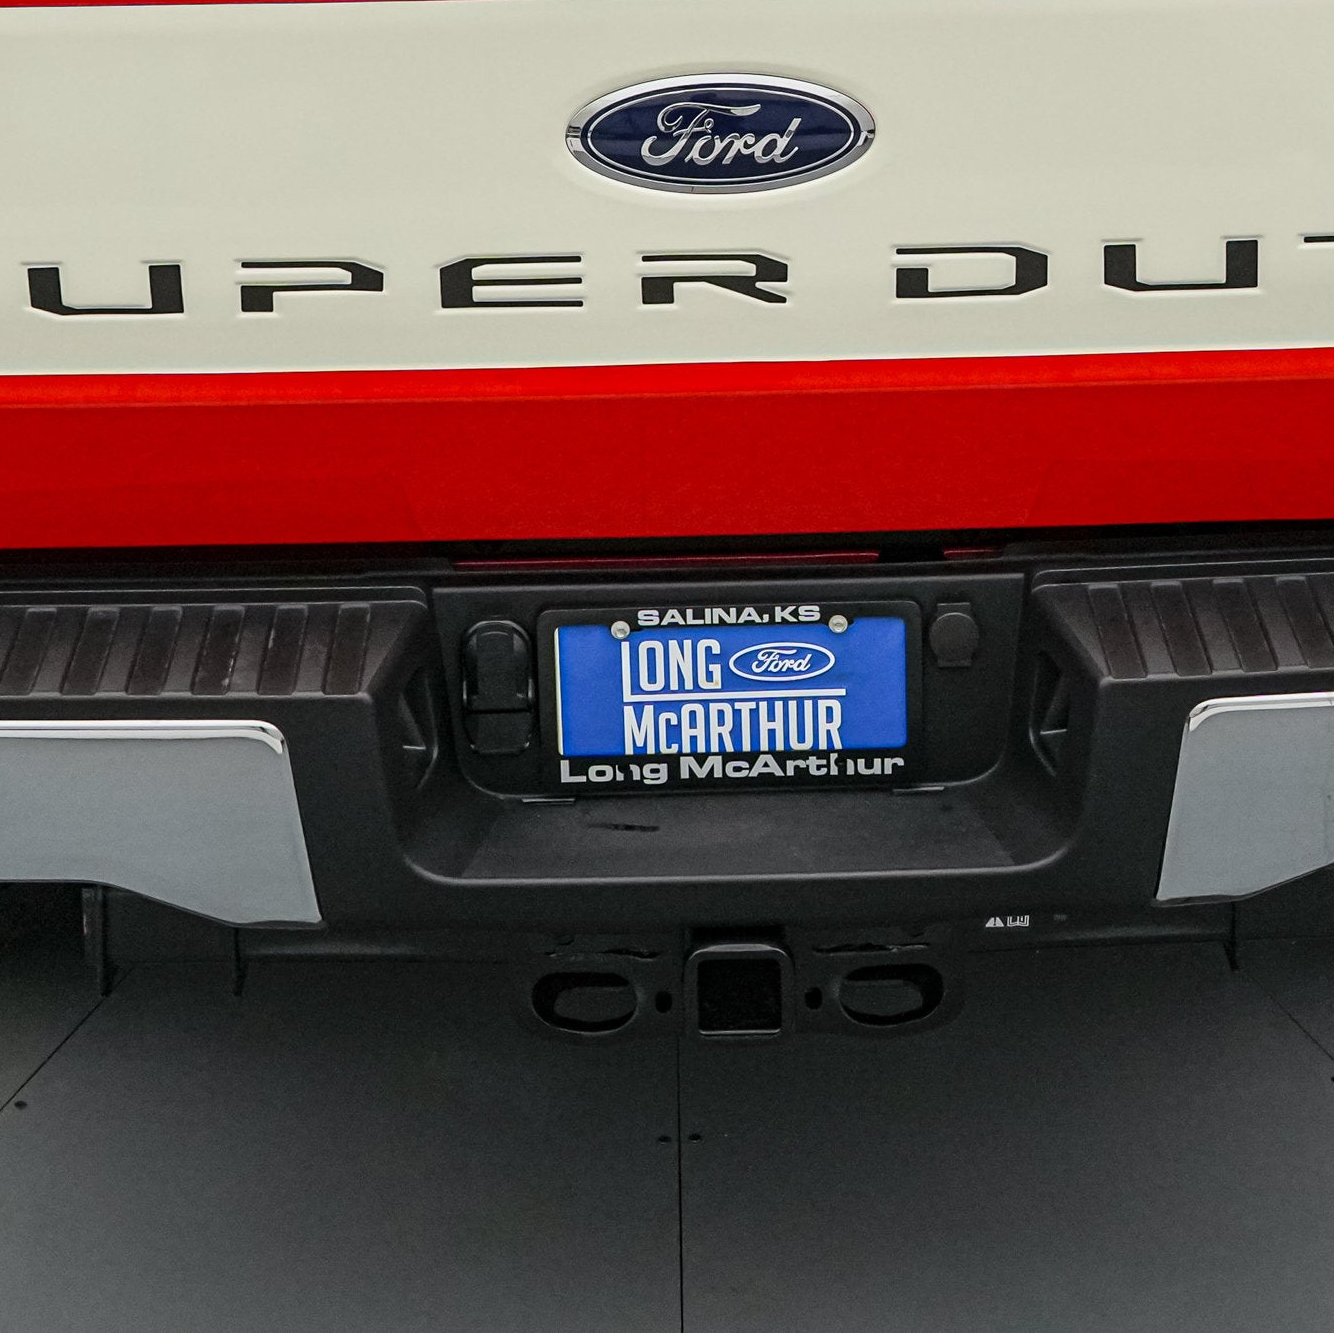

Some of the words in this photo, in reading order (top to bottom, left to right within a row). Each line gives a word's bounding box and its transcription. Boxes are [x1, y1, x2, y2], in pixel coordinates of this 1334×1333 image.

[640, 101, 803, 167] Ford
[637, 606, 770, 626] SALINA,
[774, 604, 821, 623] KS
[620, 638, 722, 700] LONG
[751, 649, 812, 673] Ford
[623, 699, 844, 755] McARTHUR
[560, 759, 668, 785] Long
[680, 752, 905, 780] McArthur
